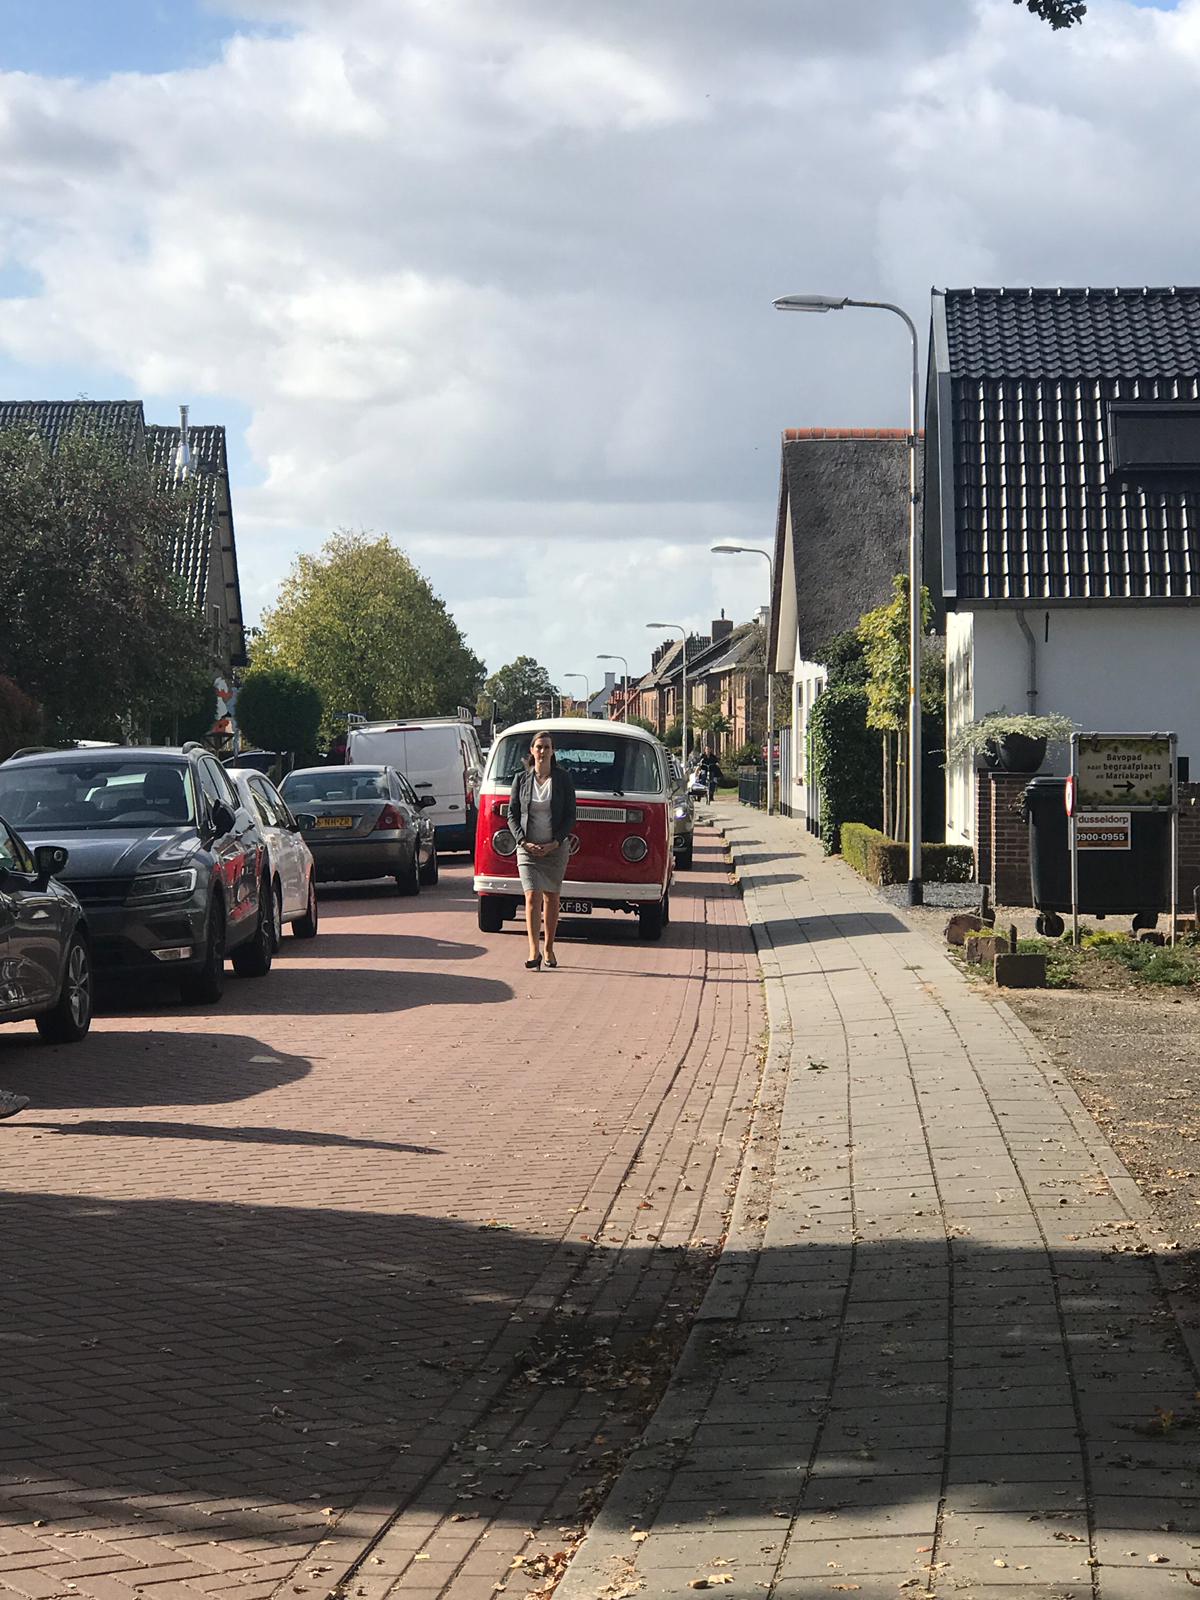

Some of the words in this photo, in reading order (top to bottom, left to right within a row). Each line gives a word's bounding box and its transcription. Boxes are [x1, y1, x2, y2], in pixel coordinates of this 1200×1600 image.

[1106, 753, 1142, 762] Bavopad
[1103, 763, 1161, 771] begraafplaats
[1105, 772, 1153, 780] Mariakapel
[1078, 815, 1129, 824] dusseldorp
[1076, 833, 1125, 841] 0900-0955
